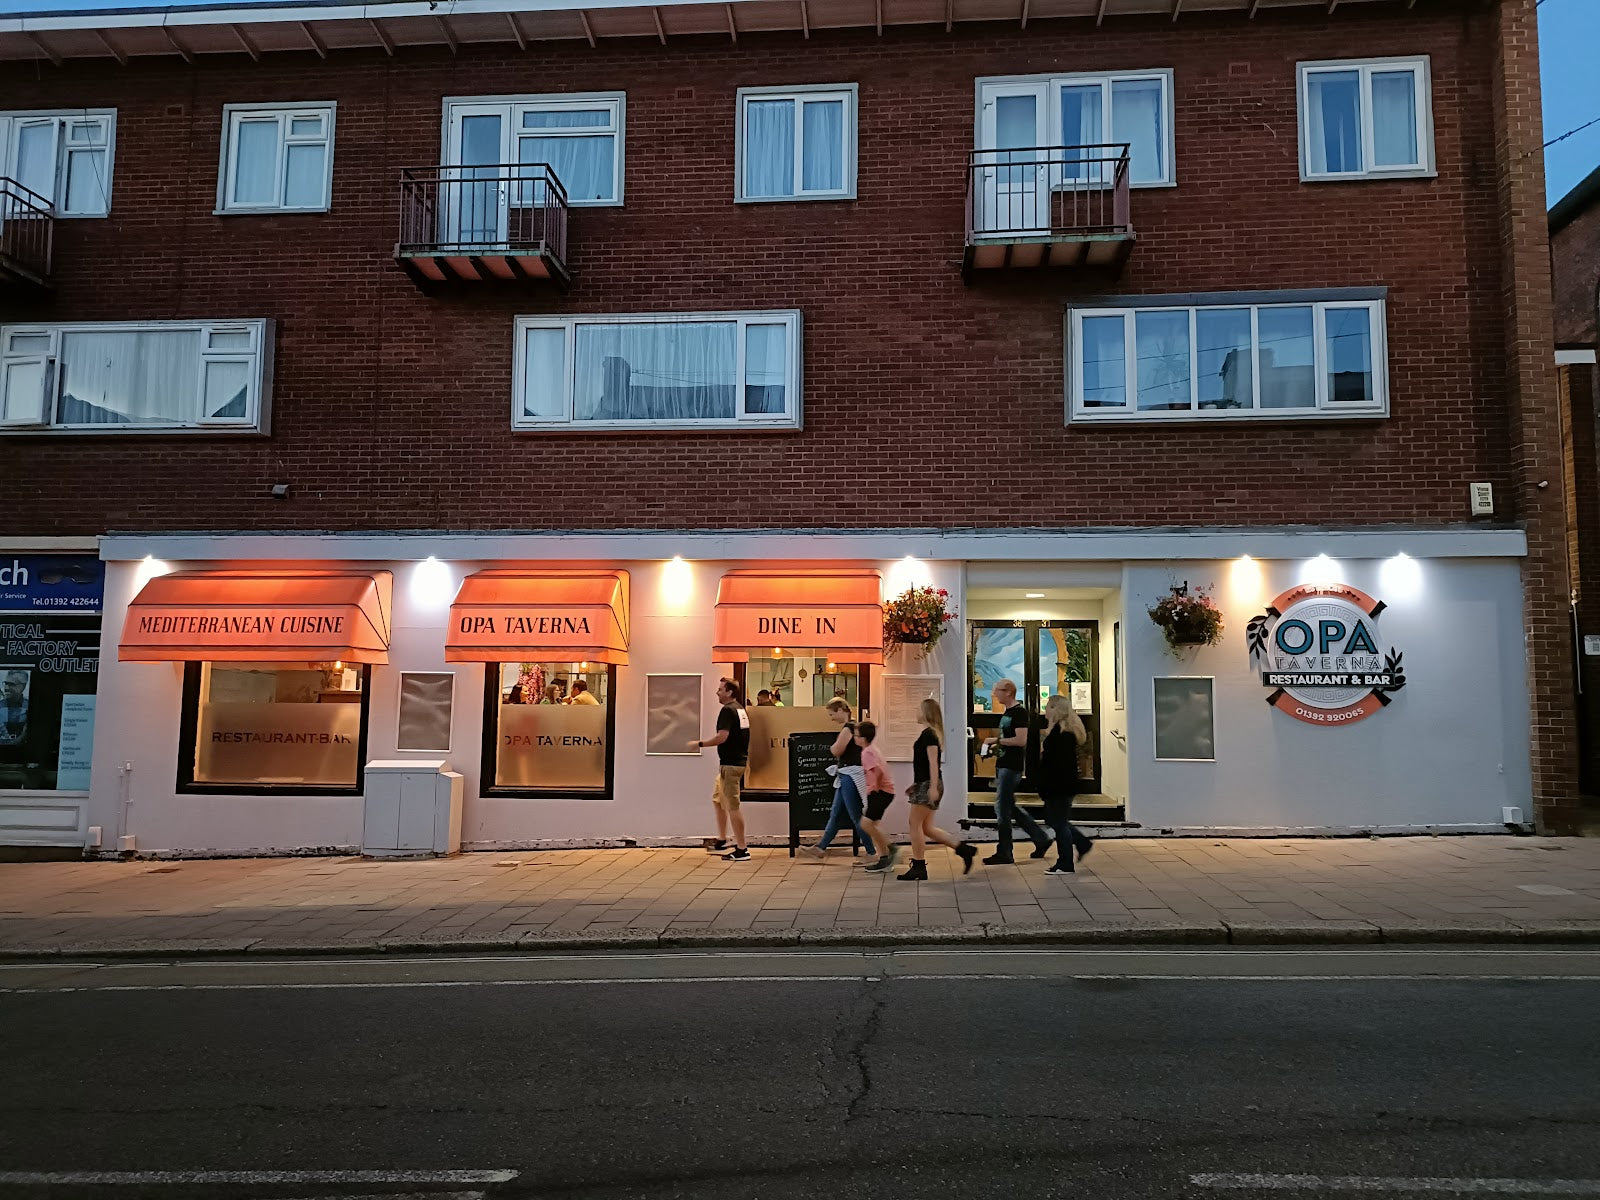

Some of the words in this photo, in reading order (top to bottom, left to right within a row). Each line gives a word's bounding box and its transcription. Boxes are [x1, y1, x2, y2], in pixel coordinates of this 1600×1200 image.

[69, 598, 99, 606] 422644
[138, 616, 276, 634] MEDITERRANEAN
[279, 616, 345, 634] CUISINE
[460, 616, 496, 634] OPA
[504, 616, 591, 634] TAVERNA
[758, 617, 802, 634] DINE
[816, 617, 837, 634] IN
[1275, 619, 1379, 656] OPA
[6, 641, 78, 656] FACTORY
[39, 657, 99, 673] OUTLET
[1275, 656, 1382, 670] TAVERNA
[1269, 674, 1348, 685] RESTAURANT
[1351, 674, 1361, 685] &
[1364, 675, 1390, 685] BAR
[1295, 706, 1325, 722] 01392
[535, 735, 603, 746] TAVERNA
